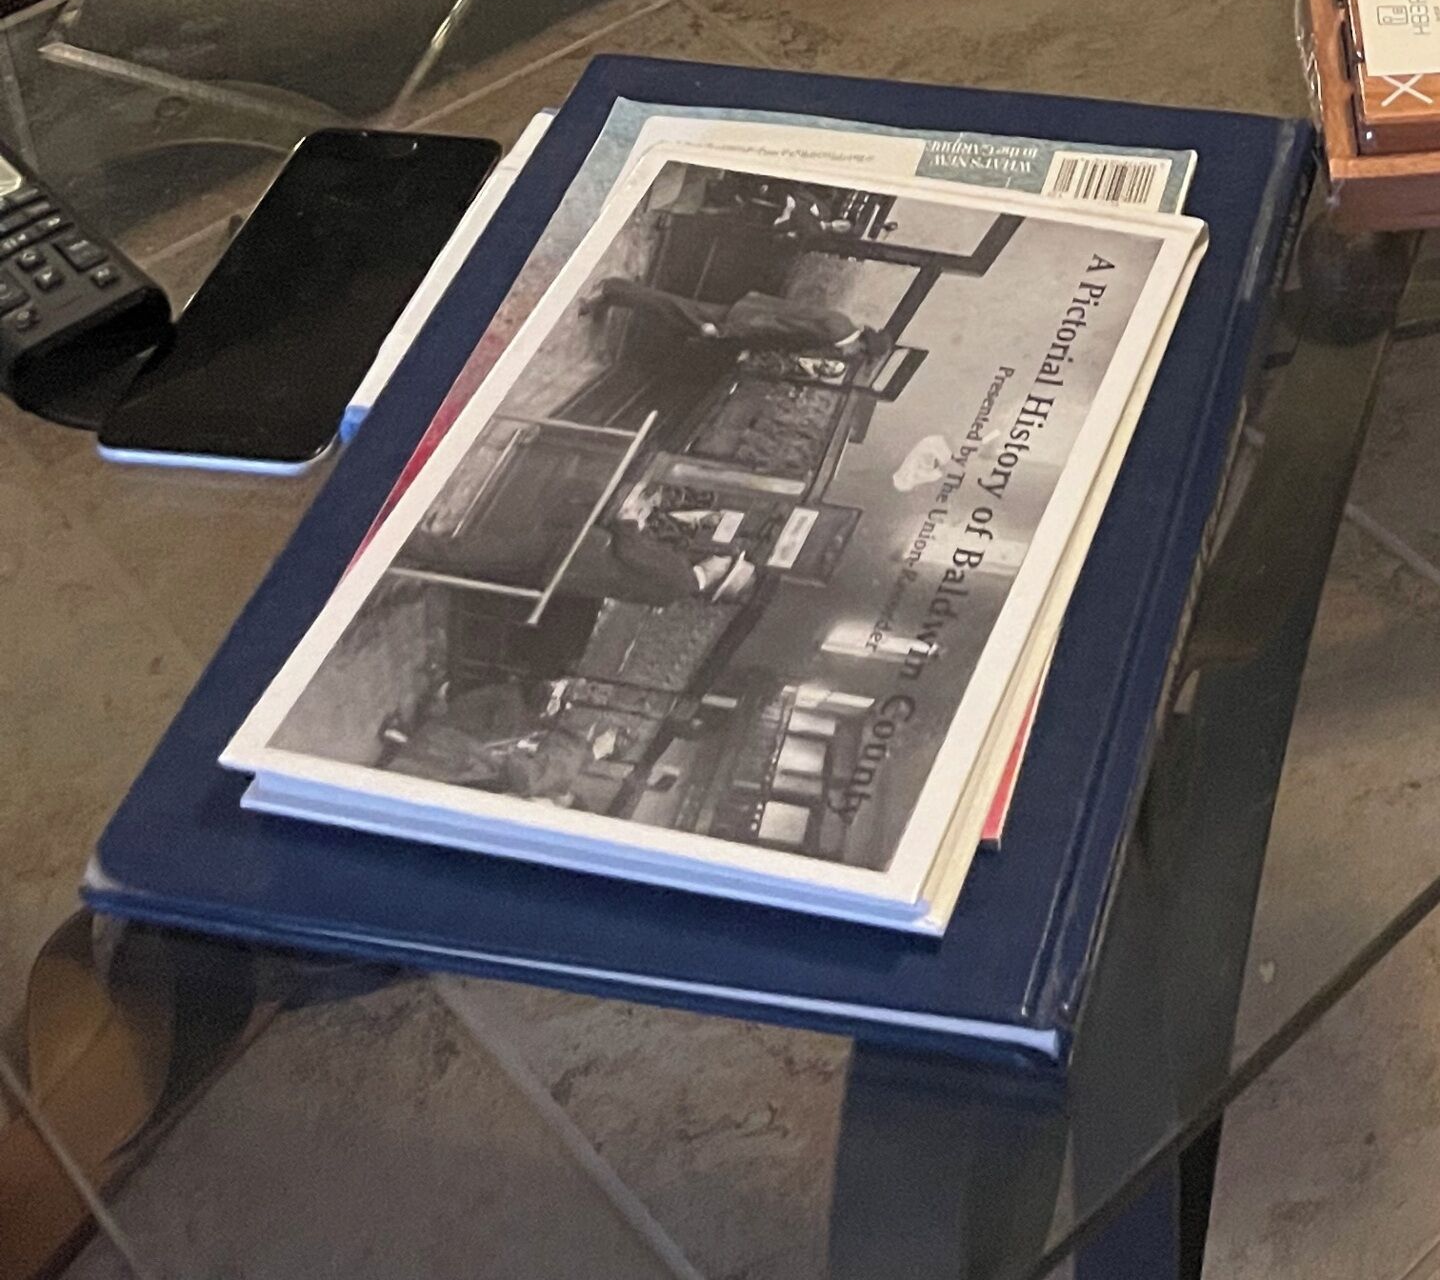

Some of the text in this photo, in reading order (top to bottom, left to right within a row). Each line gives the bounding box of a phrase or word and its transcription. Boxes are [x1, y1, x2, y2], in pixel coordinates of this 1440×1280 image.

[931, 154, 1031, 172] WHAT'S NEW
[999, 146, 1025, 158] the
[965, 366, 1016, 441] Presented
[951, 444, 978, 467] by
[935, 472, 966, 503] The
[827, 253, 1115, 827] A Pictorial History of Baldwin County
